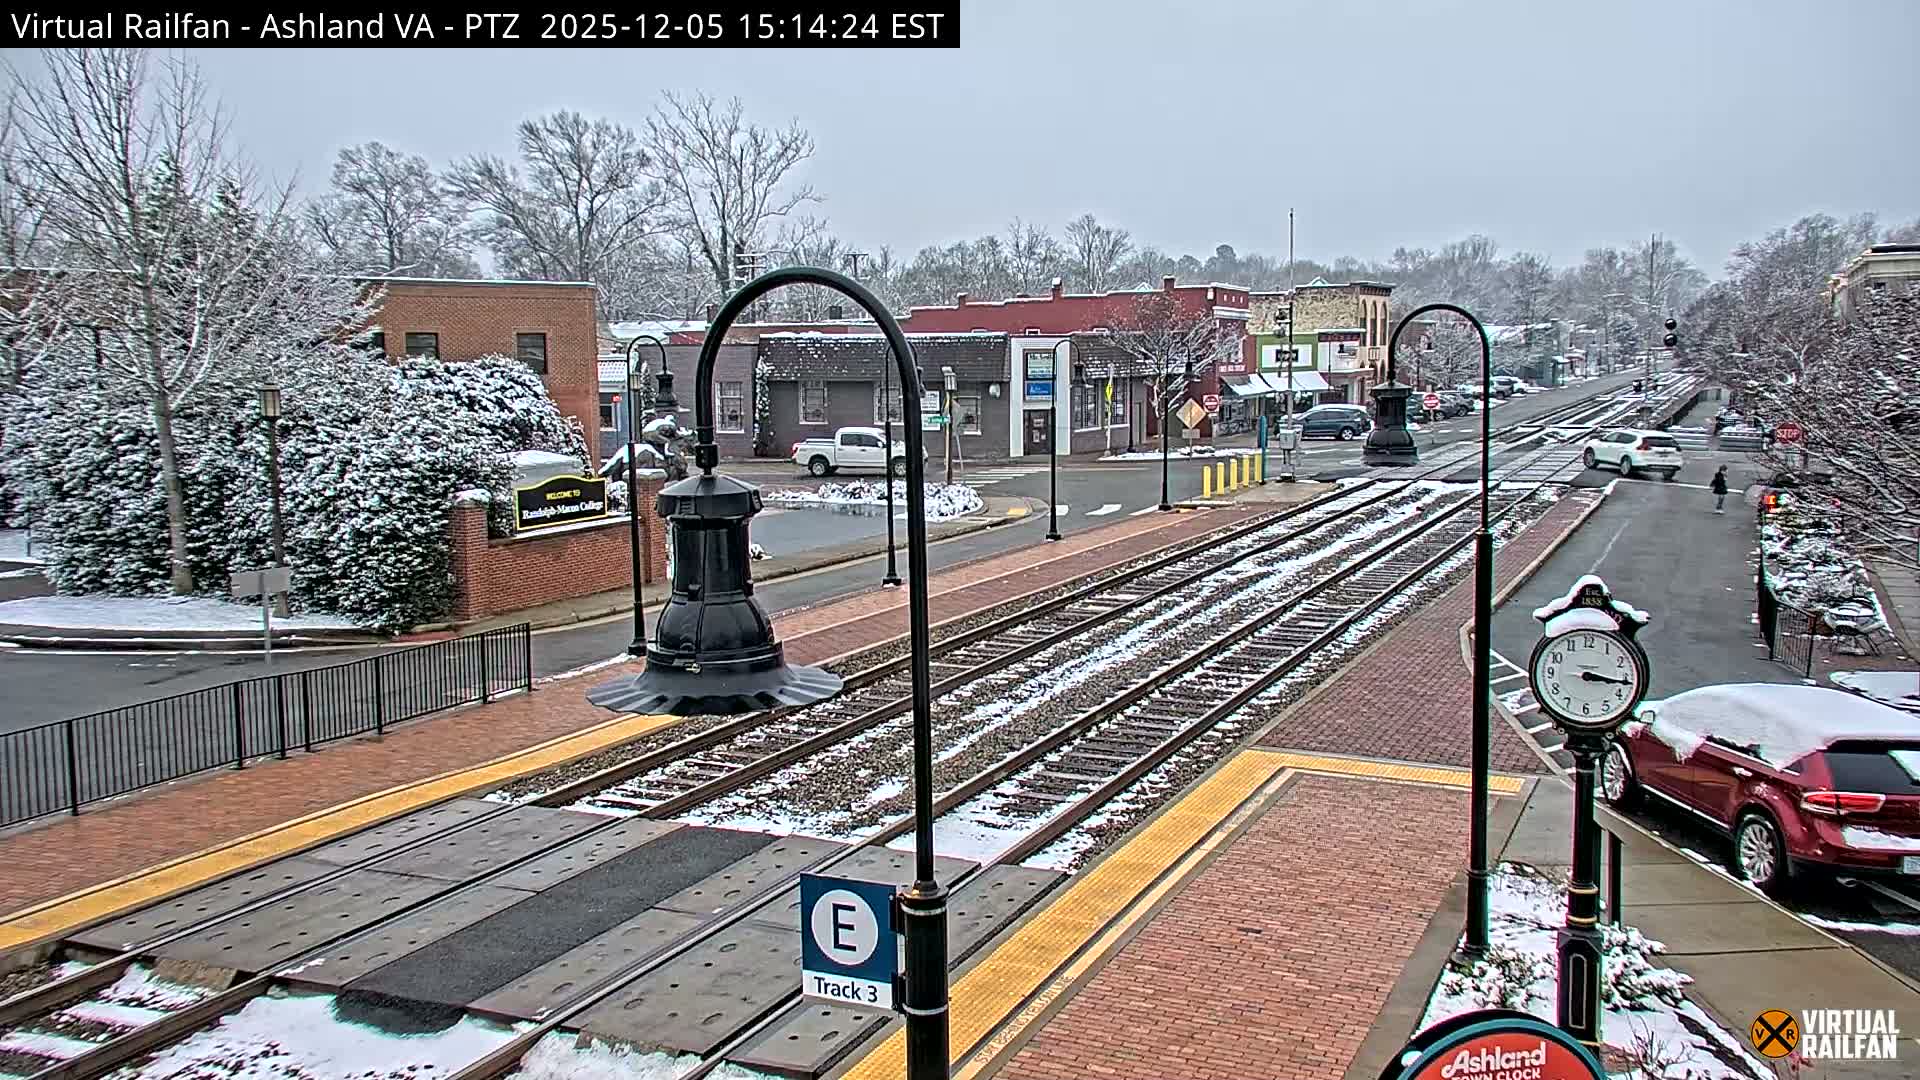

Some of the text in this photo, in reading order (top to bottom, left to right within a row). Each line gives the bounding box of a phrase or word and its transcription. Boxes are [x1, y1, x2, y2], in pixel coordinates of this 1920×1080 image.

[1776, 428, 1800, 438] STOP
[1567, 639, 1576, 652] 11
[1583, 636, 1595, 649] 12
[1604, 642, 1610, 655] 1
[1552, 652, 1563, 664] 10
[1616, 656, 1624, 668] 2
[1547, 667, 1554, 679] 9
[1551, 682, 1560, 695] 8
[1615, 688, 1623, 701] 4
[1563, 697, 1571, 709] 7
[1582, 703, 1590, 715] 6
[1600, 700, 1610, 712] 5
[831, 902, 857, 952] E
[813, 976, 878, 1003] Track 3
[1441, 1040, 1546, 1079] Ashland
